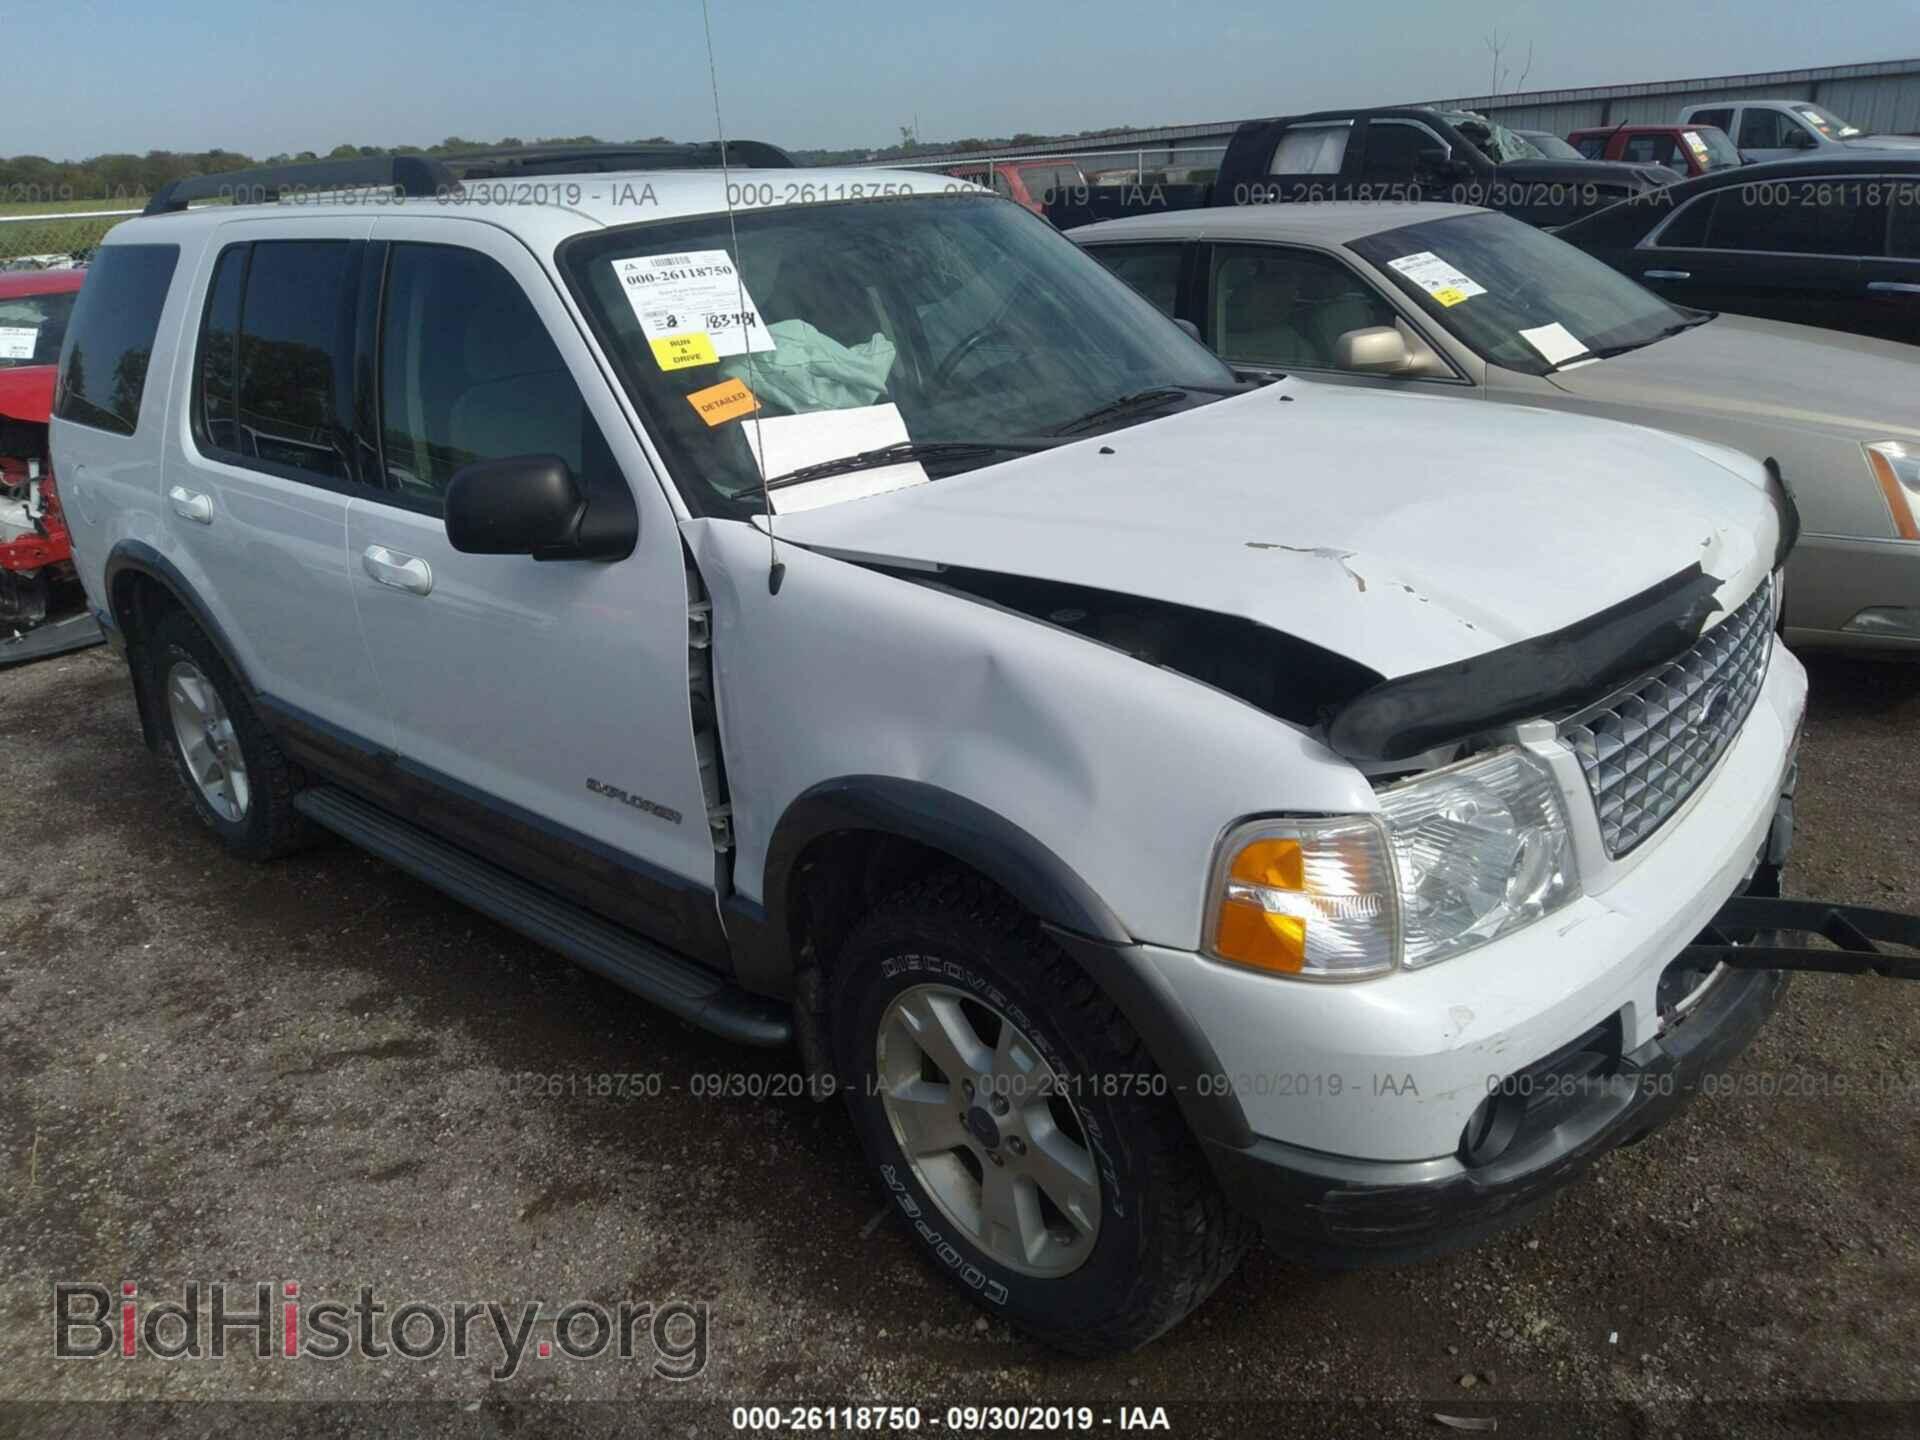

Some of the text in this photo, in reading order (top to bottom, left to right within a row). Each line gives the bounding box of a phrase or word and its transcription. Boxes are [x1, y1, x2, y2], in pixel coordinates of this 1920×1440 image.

[626, 265, 732, 285] 000-26118750
[670, 338, 691, 346] RUN
[673, 353, 702, 364] DRIVE
[702, 391, 747, 412] DETAILED
[586, 778, 683, 824] EXPLORER
[880, 1163, 1009, 1305] COOPER
